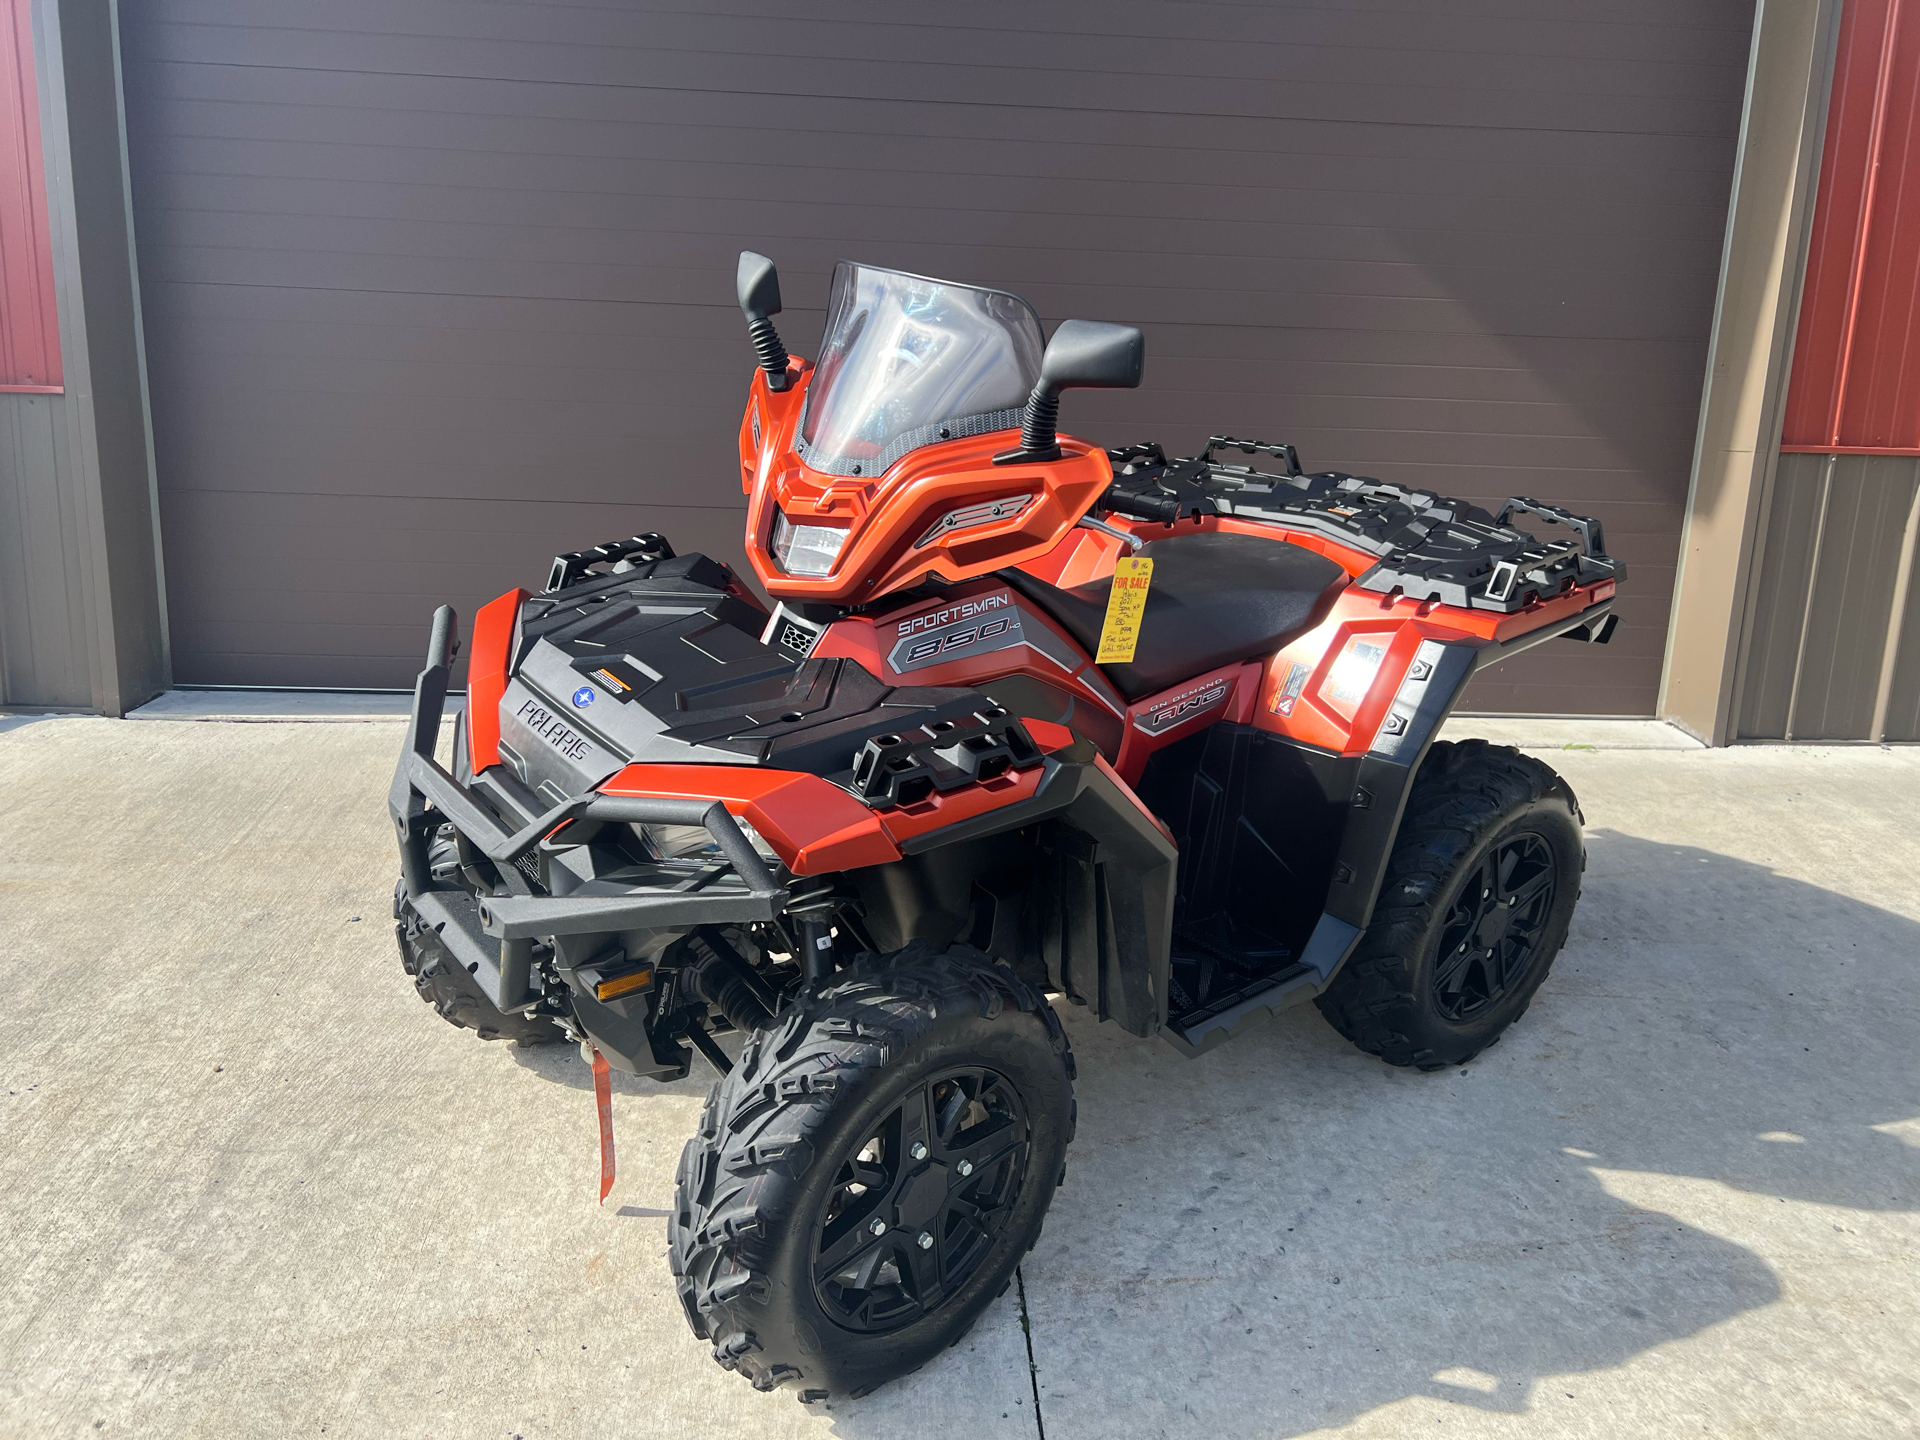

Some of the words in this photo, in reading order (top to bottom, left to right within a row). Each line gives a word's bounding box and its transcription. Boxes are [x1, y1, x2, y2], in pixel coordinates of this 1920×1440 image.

[1113, 576, 1129, 589] FOR
[1129, 576, 1149, 589] SALE
[897, 593, 1008, 637] SPORTSMAN
[905, 617, 1010, 664] 850
[1149, 700, 1168, 712] ON
[1172, 677, 1223, 703] DEMAND
[1151, 685, 1226, 726] AWD
[515, 698, 593, 764] POLARIS
[599, 1104, 615, 1179] POLARIS
